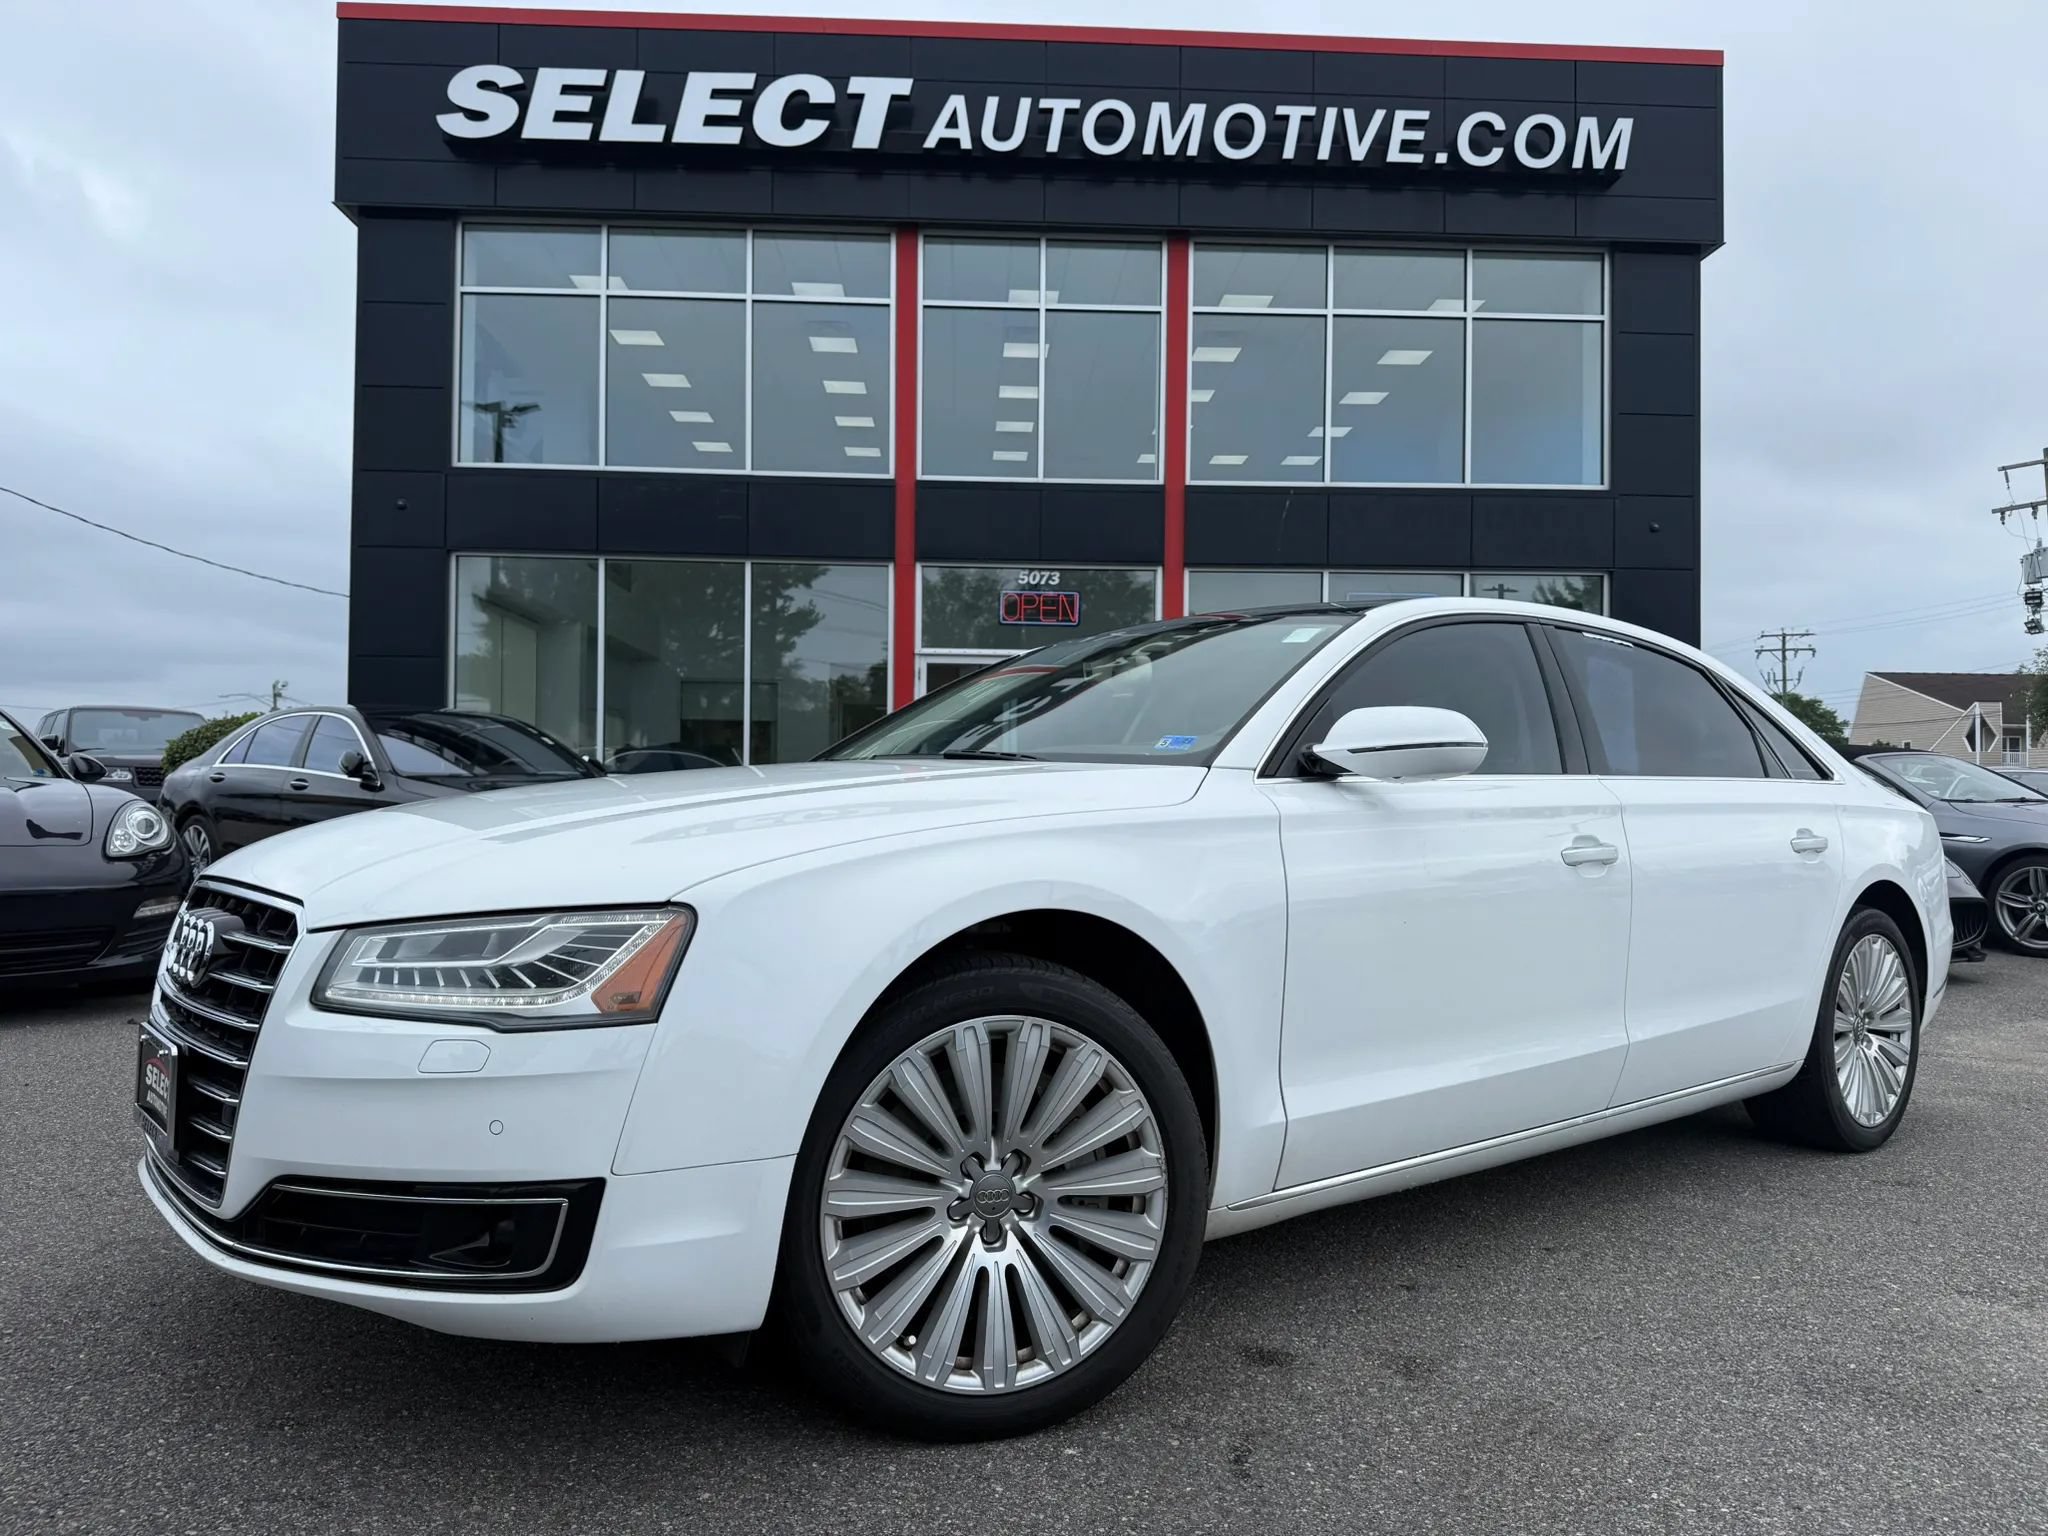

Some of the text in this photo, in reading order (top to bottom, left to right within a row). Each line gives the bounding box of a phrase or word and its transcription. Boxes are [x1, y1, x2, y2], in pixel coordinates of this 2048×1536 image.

[436, 65, 1634, 170] SELECT AUTOMOTIVE.COM
[1018, 570, 1061, 585] 5073
[1003, 592, 1078, 623] OPEN
[145, 1063, 169, 1099] SELEC
